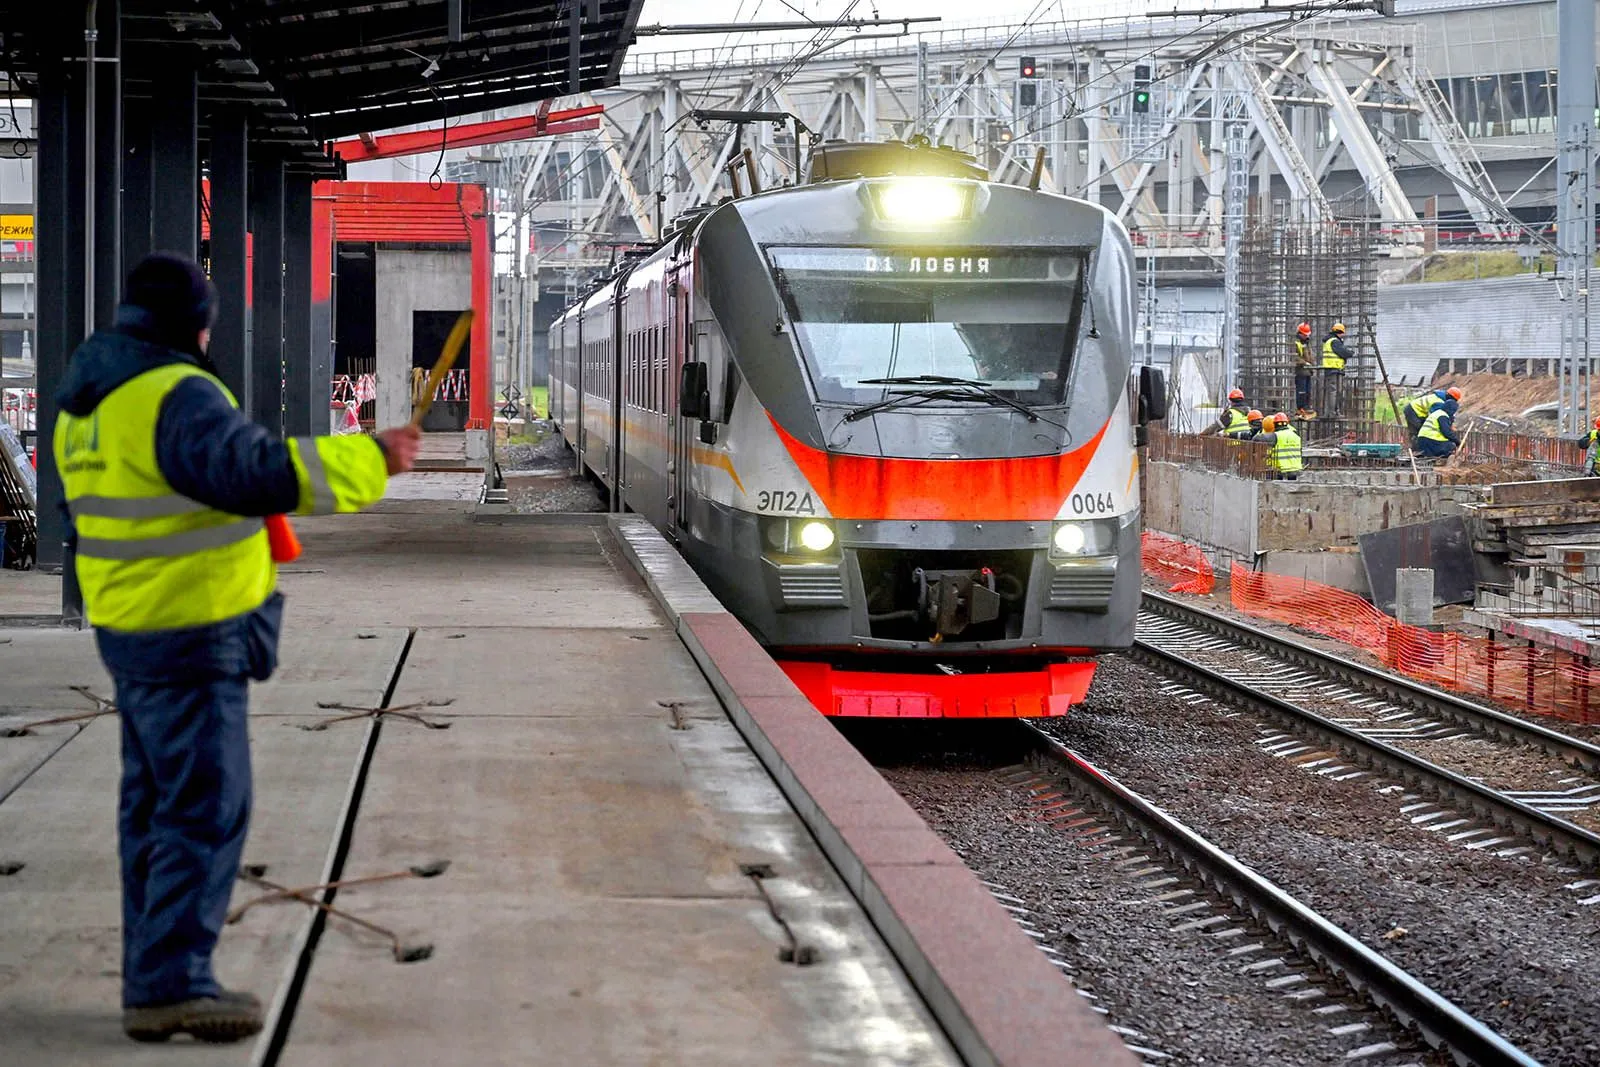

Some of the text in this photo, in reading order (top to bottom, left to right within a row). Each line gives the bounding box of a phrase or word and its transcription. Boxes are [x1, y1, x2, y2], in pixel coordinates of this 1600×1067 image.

[865, 256, 989, 273] D1 ЛОБНЯ
[757, 490, 816, 515] ЭП2Д
[1072, 492, 1114, 514] 0064
